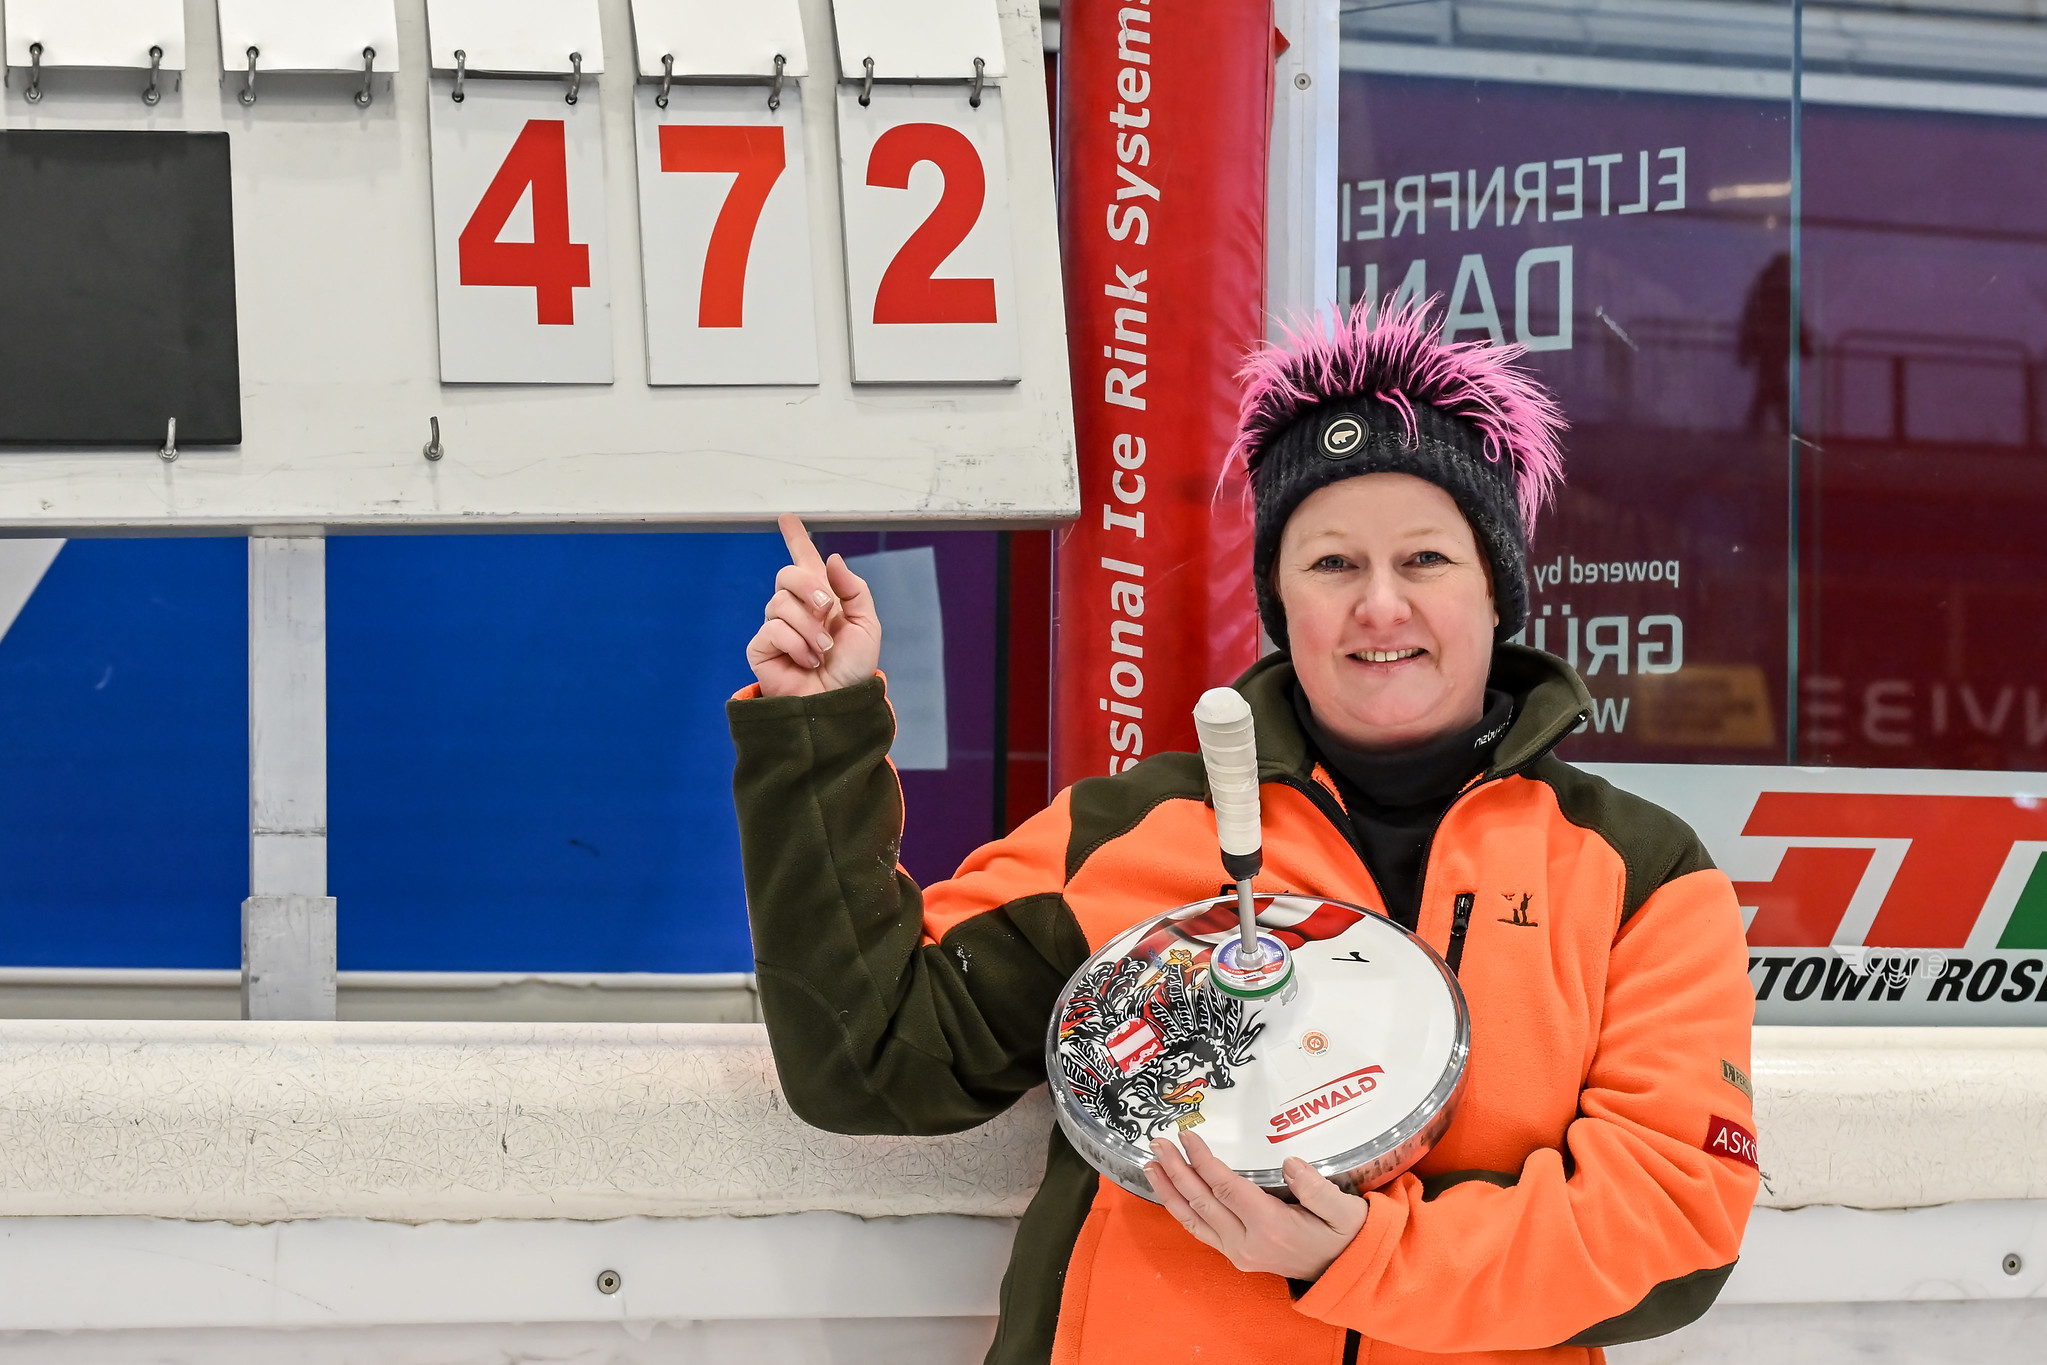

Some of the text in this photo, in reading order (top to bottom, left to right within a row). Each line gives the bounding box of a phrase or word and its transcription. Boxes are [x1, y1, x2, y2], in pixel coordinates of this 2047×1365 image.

[1106, 0, 1161, 245] System
[1103, 265, 1149, 412] Rink
[1102, 433, 1146, 539] Ice
[1744, 956, 2047, 1002] TOWN ROS
[1269, 1076, 1377, 1133] SEIWALD
